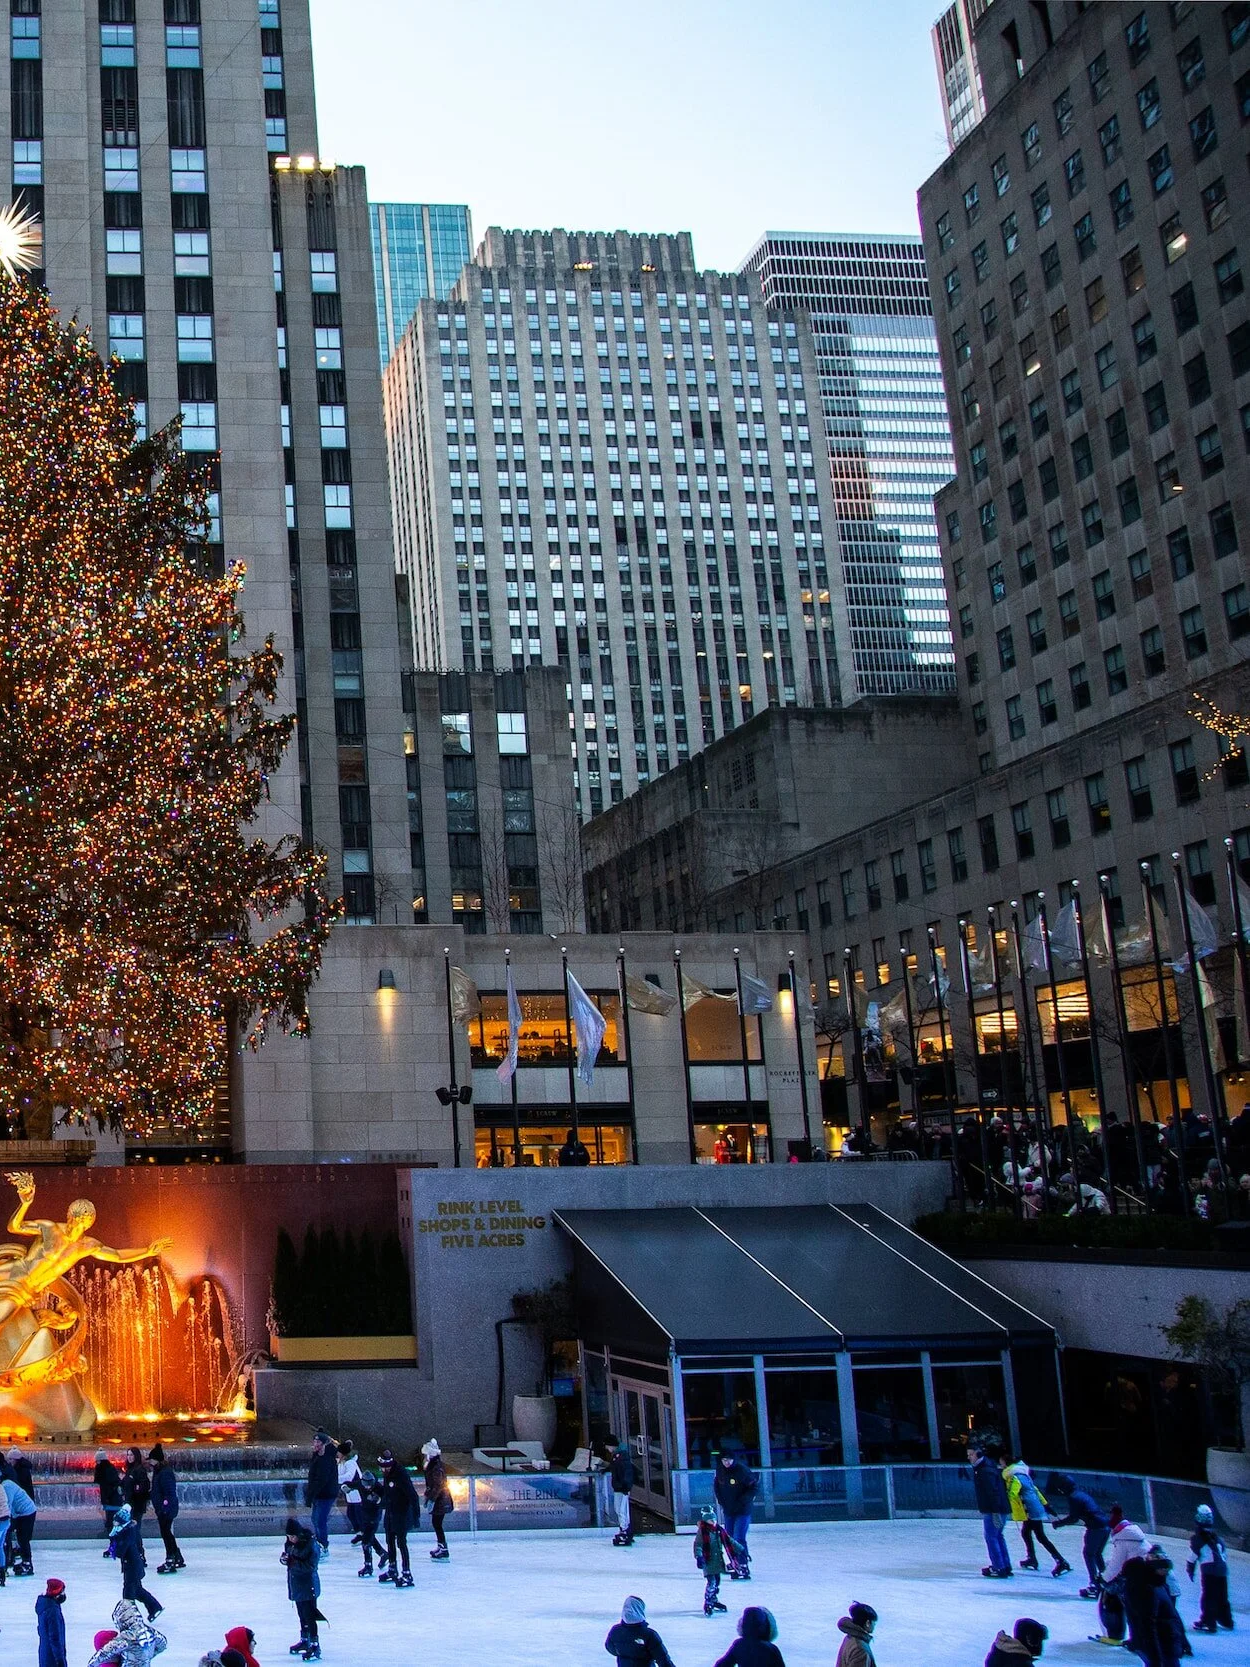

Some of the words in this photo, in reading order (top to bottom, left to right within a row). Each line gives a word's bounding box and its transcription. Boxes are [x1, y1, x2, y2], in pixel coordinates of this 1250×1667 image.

[437, 1201, 476, 1215] RINK
[479, 1200, 525, 1213] LEVEL
[418, 1218, 470, 1233] SHOPS
[474, 1217, 485, 1231] &
[489, 1216, 546, 1230] DINING
[441, 1235, 474, 1248] FIVE
[478, 1233, 525, 1247] ACRES
[222, 1496, 241, 1507] THE
[245, 1495, 271, 1507] RINK
[512, 1489, 531, 1500] THE
[535, 1489, 560, 1500] RINK
